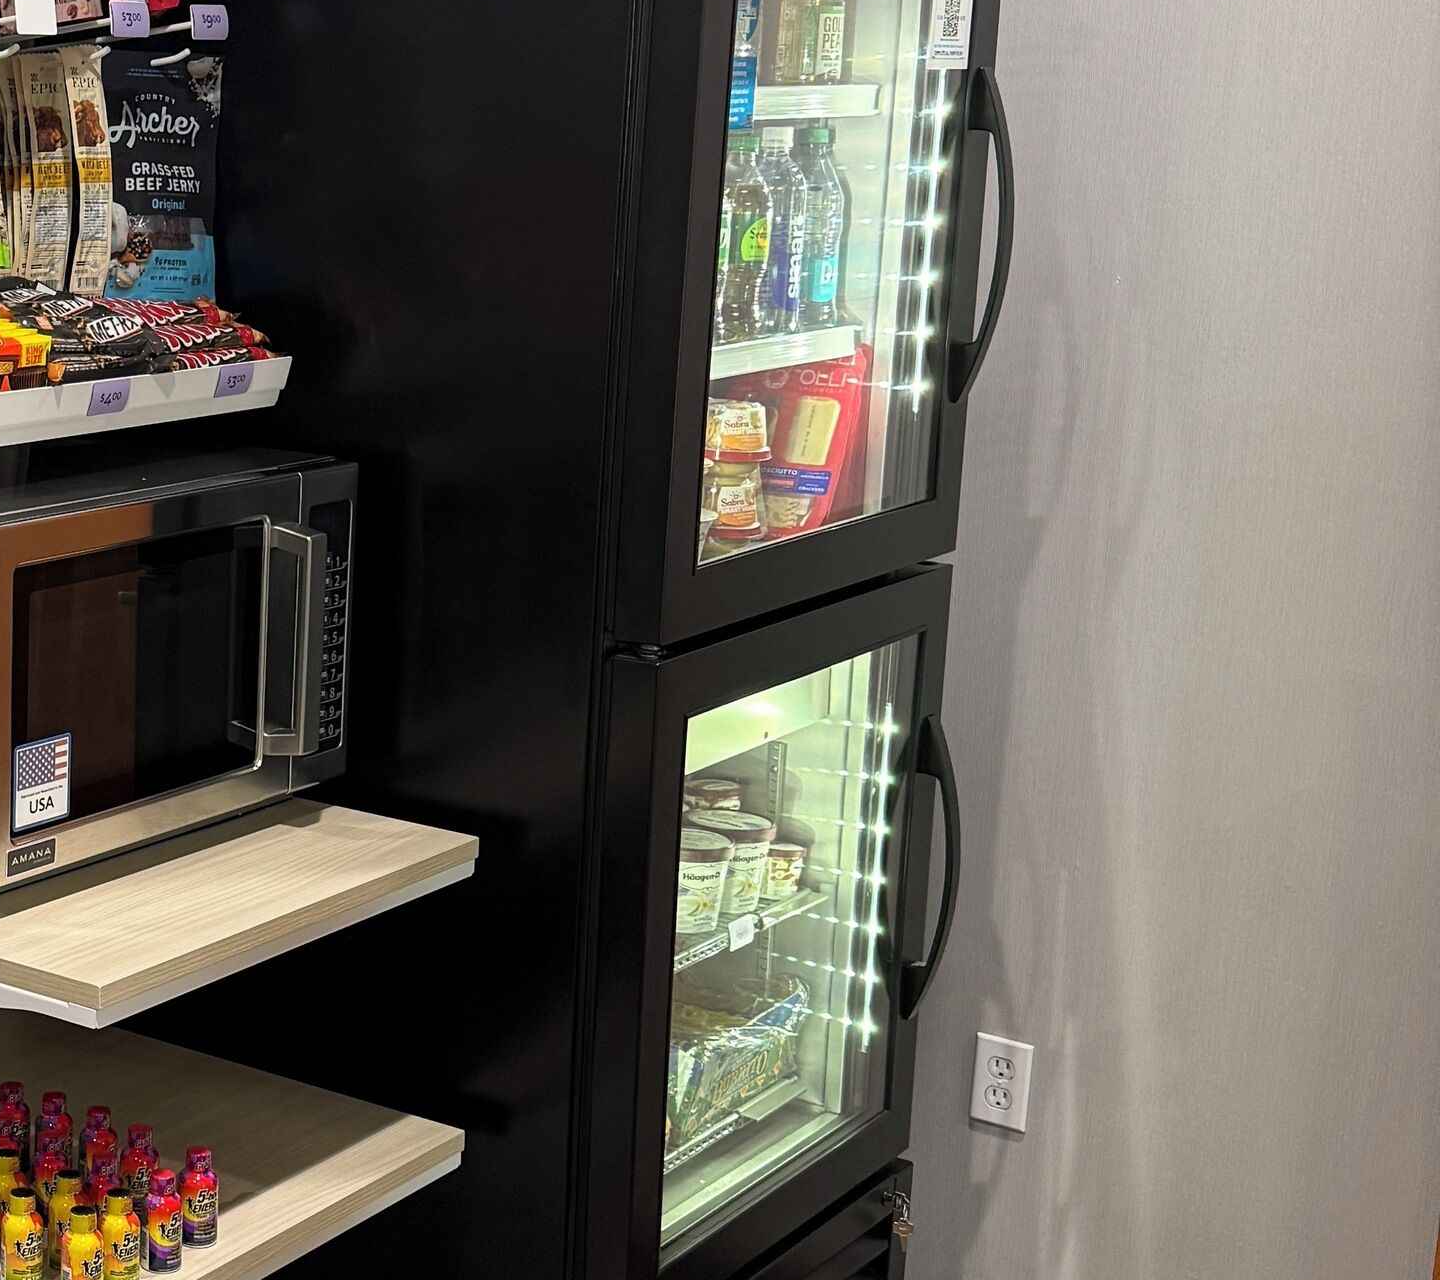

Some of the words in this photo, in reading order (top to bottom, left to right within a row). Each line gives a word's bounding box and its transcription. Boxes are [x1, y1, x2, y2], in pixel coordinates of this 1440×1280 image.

[822, 32, 841, 49] PEA
[135, 93, 176, 105] COUNTRY
[110, 100, 201, 149] Archer
[131, 162, 195, 178] GRASS-FED
[125, 177, 163, 192] BEEF
[166, 179, 201, 194] JERKY
[151, 197, 186, 211] Original
[25, 344, 44, 357] KING
[25, 354, 44, 366] SIZE
[724, 420, 750, 430] Sabra
[720, 497, 745, 507] Sabra
[29, 796, 55, 814] USA
[11, 847, 52, 866] AMANA
[682, 872, 720, 881] Häagen-D
